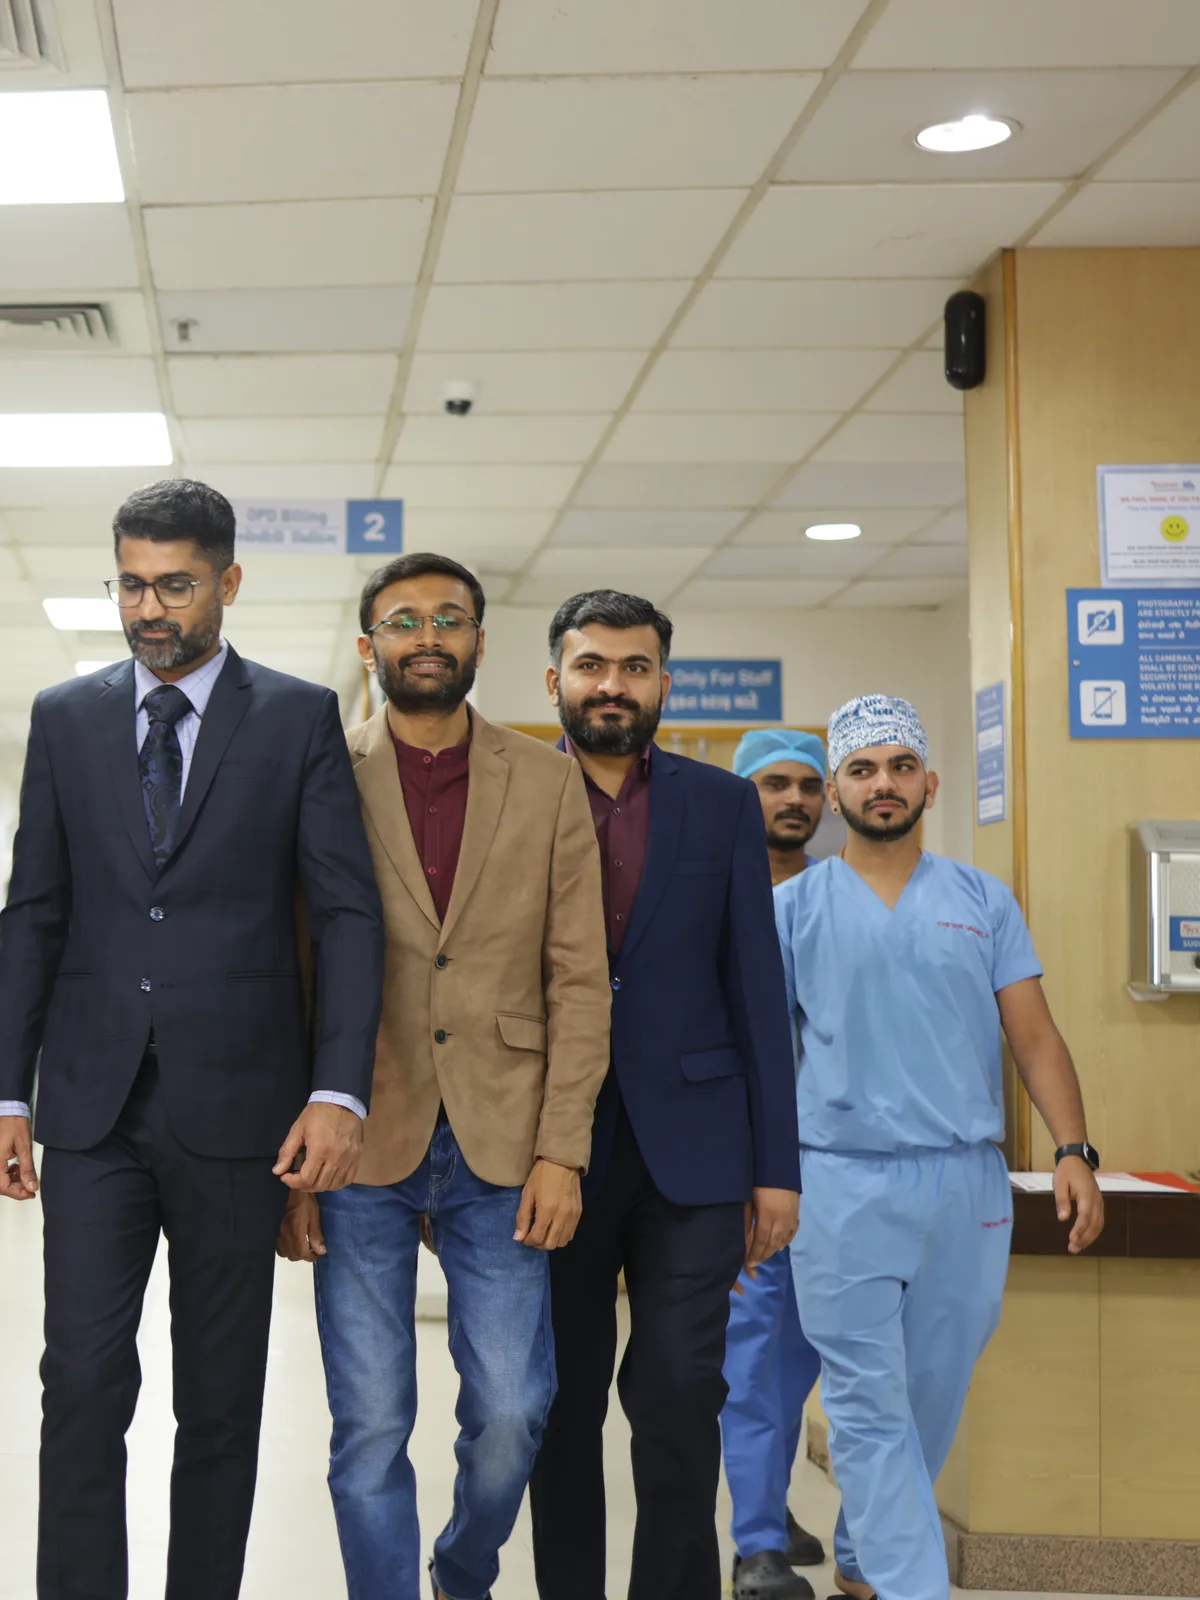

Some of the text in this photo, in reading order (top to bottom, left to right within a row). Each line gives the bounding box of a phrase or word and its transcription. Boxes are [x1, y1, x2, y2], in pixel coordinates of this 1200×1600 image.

[363, 512, 386, 542] 2
[1137, 599, 1193, 607] PHOTOGRAPHY
[1137, 609, 1153, 617] ARE
[1155, 609, 1190, 617] STRICTLY
[1139, 654, 1153, 662] ALL
[1155, 654, 1194, 664] CAMERAS,
[673, 667, 773, 690] Only For Staff
[1140, 673, 1176, 681] SECURITY
